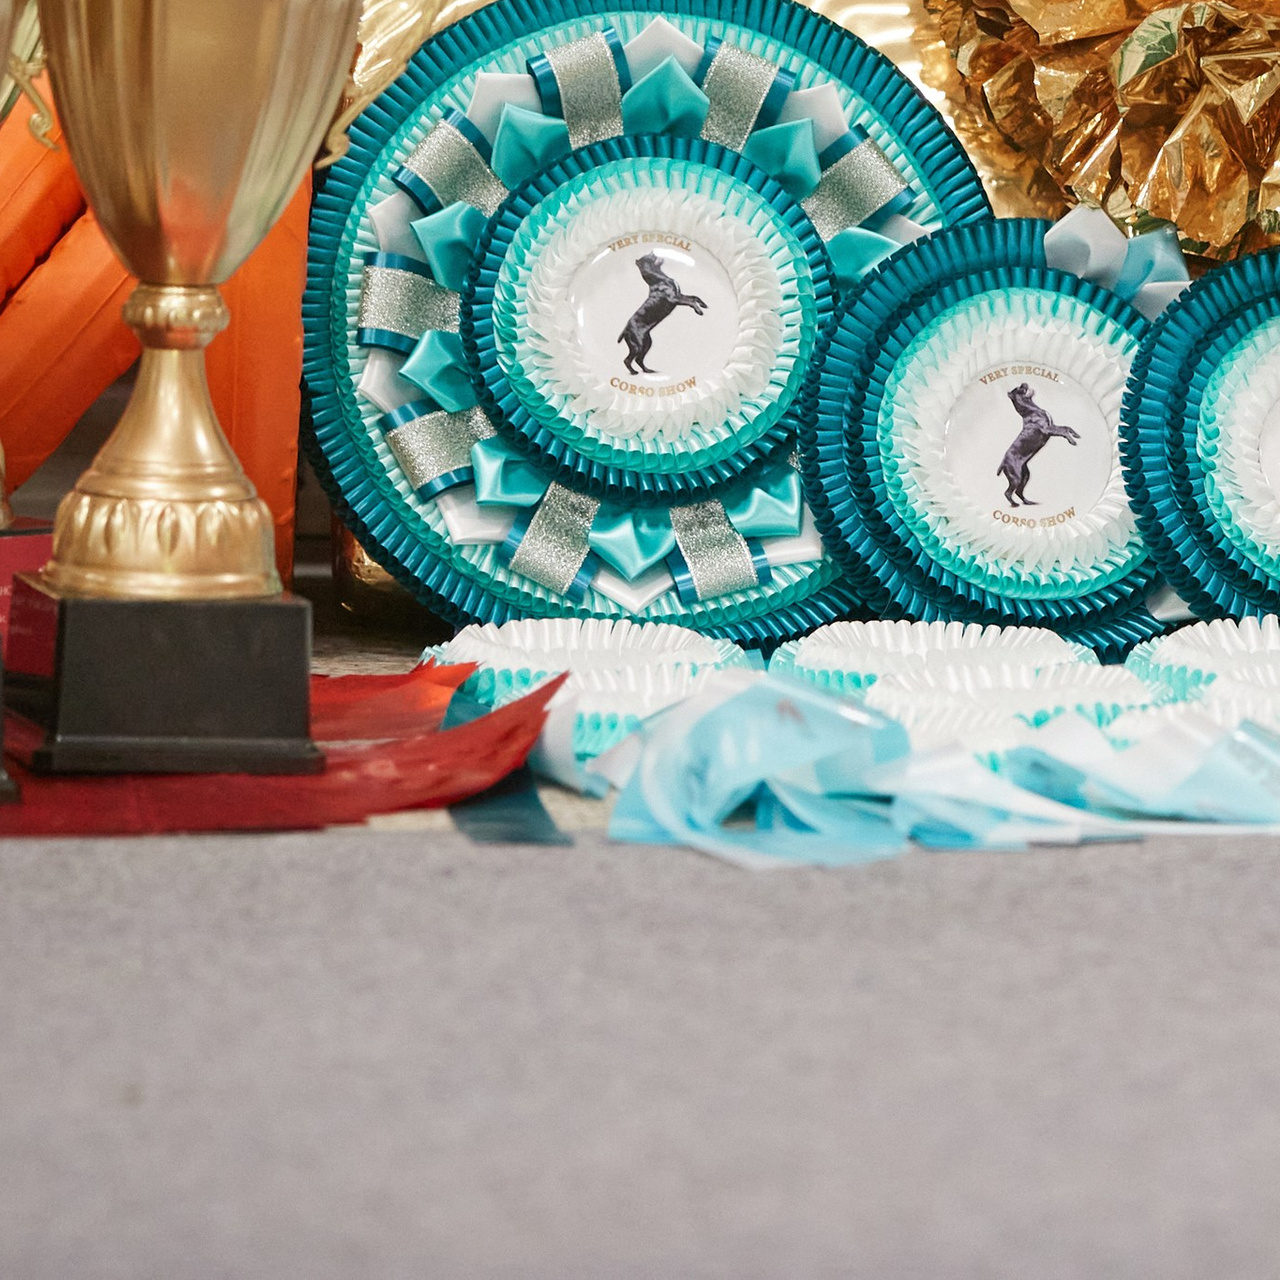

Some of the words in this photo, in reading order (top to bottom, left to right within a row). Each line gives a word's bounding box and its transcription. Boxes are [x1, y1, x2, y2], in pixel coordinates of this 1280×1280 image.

[607, 233, 639, 253] VERY
[642, 232, 692, 253] SPECIAL
[610, 376, 655, 398] CORSO
[658, 375, 698, 398] SHOW
[978, 366, 1009, 387] VERY
[1011, 364, 1060, 384] SPECIAL
[992, 509, 1036, 529] CORSO
[1039, 506, 1077, 529] SHOW
